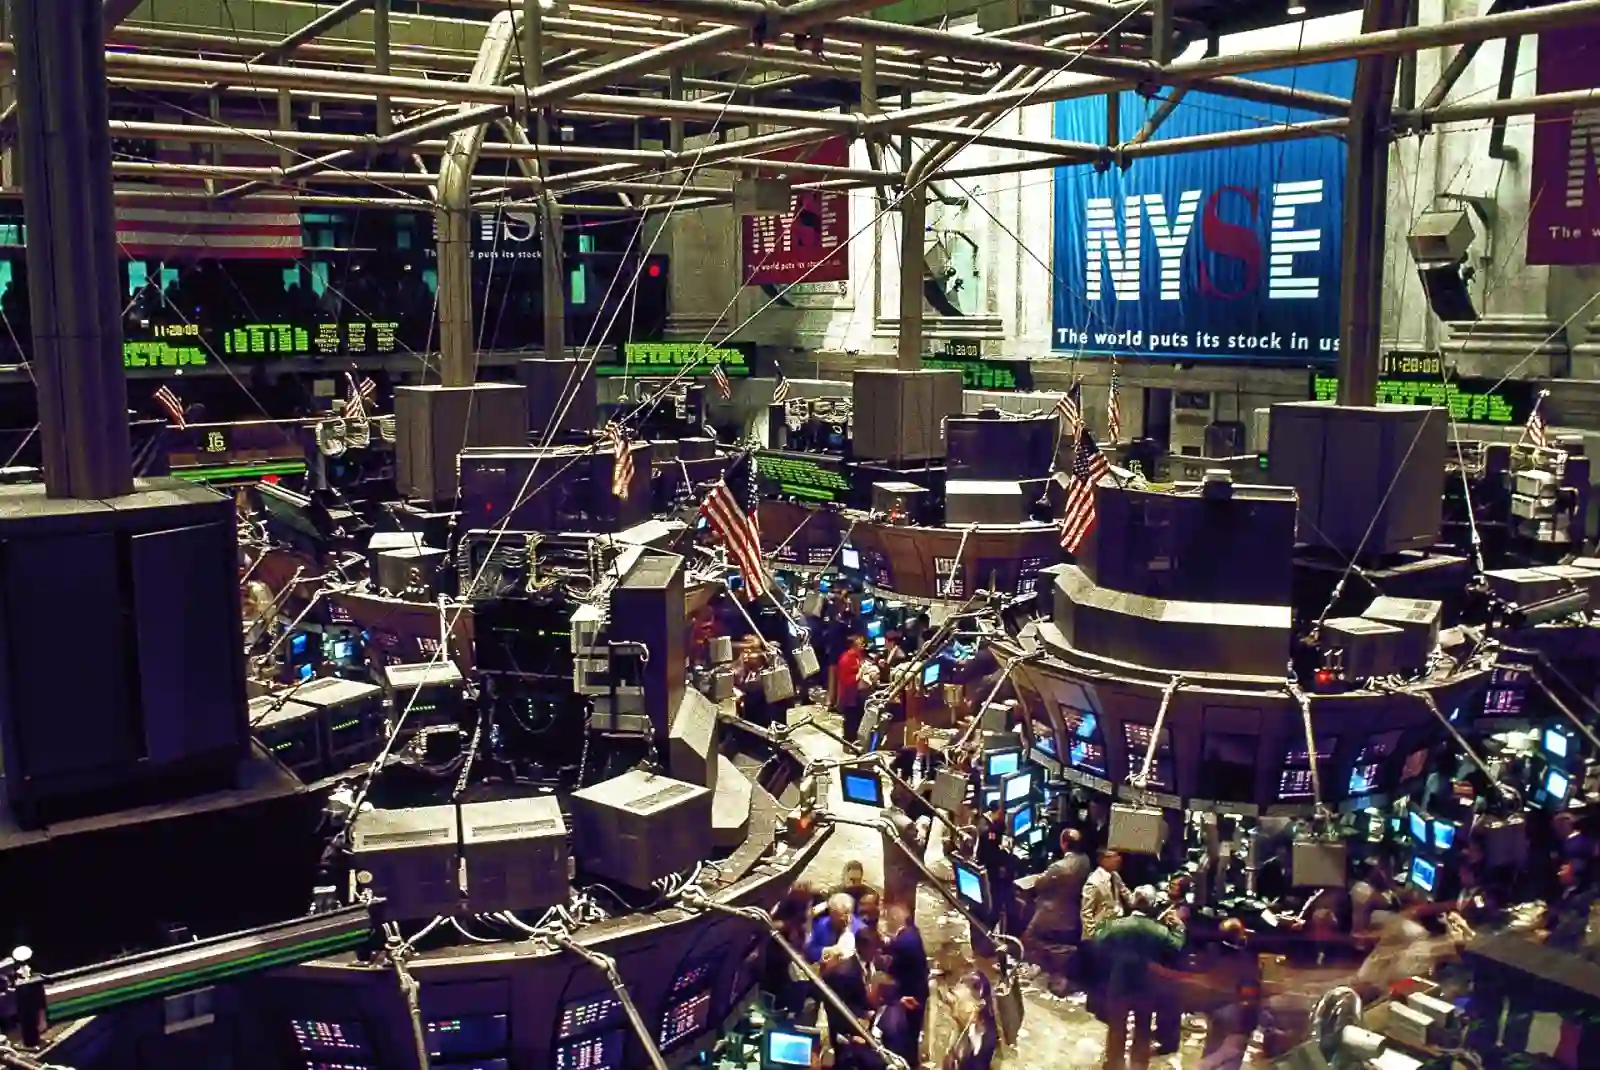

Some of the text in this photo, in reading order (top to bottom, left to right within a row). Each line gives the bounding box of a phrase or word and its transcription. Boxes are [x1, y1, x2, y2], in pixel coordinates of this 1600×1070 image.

[1086, 179, 1323, 301] NYSE
[1549, 225, 1582, 239] The
[424, 249, 437, 257] Th
[518, 250, 542, 258] stock
[1058, 328, 1088, 345] The
[1095, 330, 1142, 346] world
[1150, 332, 1188, 350] puts
[1196, 331, 1220, 348] its
[1228, 332, 1282, 349] stock
[1291, 332, 1309, 350] in
